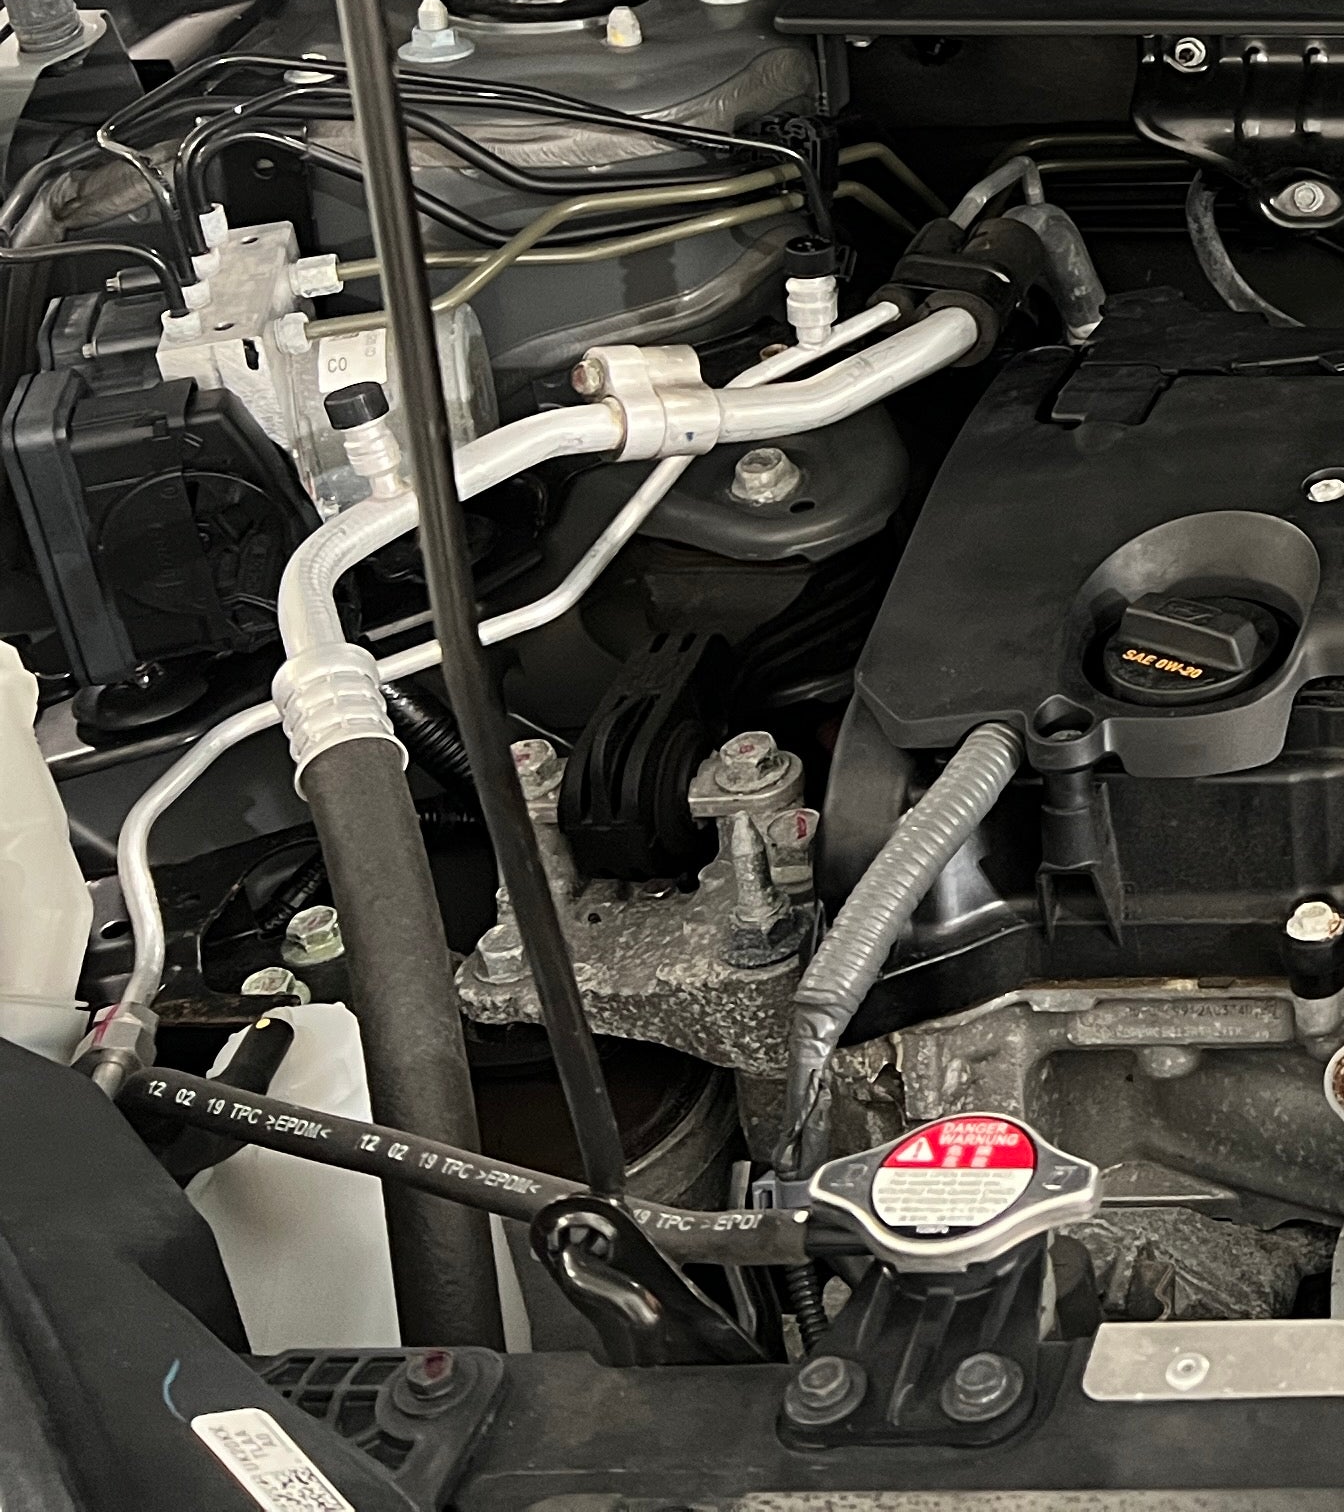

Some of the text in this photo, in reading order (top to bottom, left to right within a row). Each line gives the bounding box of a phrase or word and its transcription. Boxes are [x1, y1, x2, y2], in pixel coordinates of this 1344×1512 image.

[1122, 649, 1203, 678] SAE 0W-20
[148, 1080, 167, 1097] 12
[175, 1088, 196, 1106] 02
[206, 1097, 226, 1115] 19
[230, 1102, 263, 1124] TPC
[942, 1121, 1009, 1134] DANGER
[938, 1133, 1020, 1147] WARNUNG
[359, 1134, 381, 1152] 12
[387, 1142, 409, 1161] 02
[418, 1151, 440, 1169] 19
[441, 1156, 474, 1180] TPC
[655, 1212, 696, 1231] TPC
